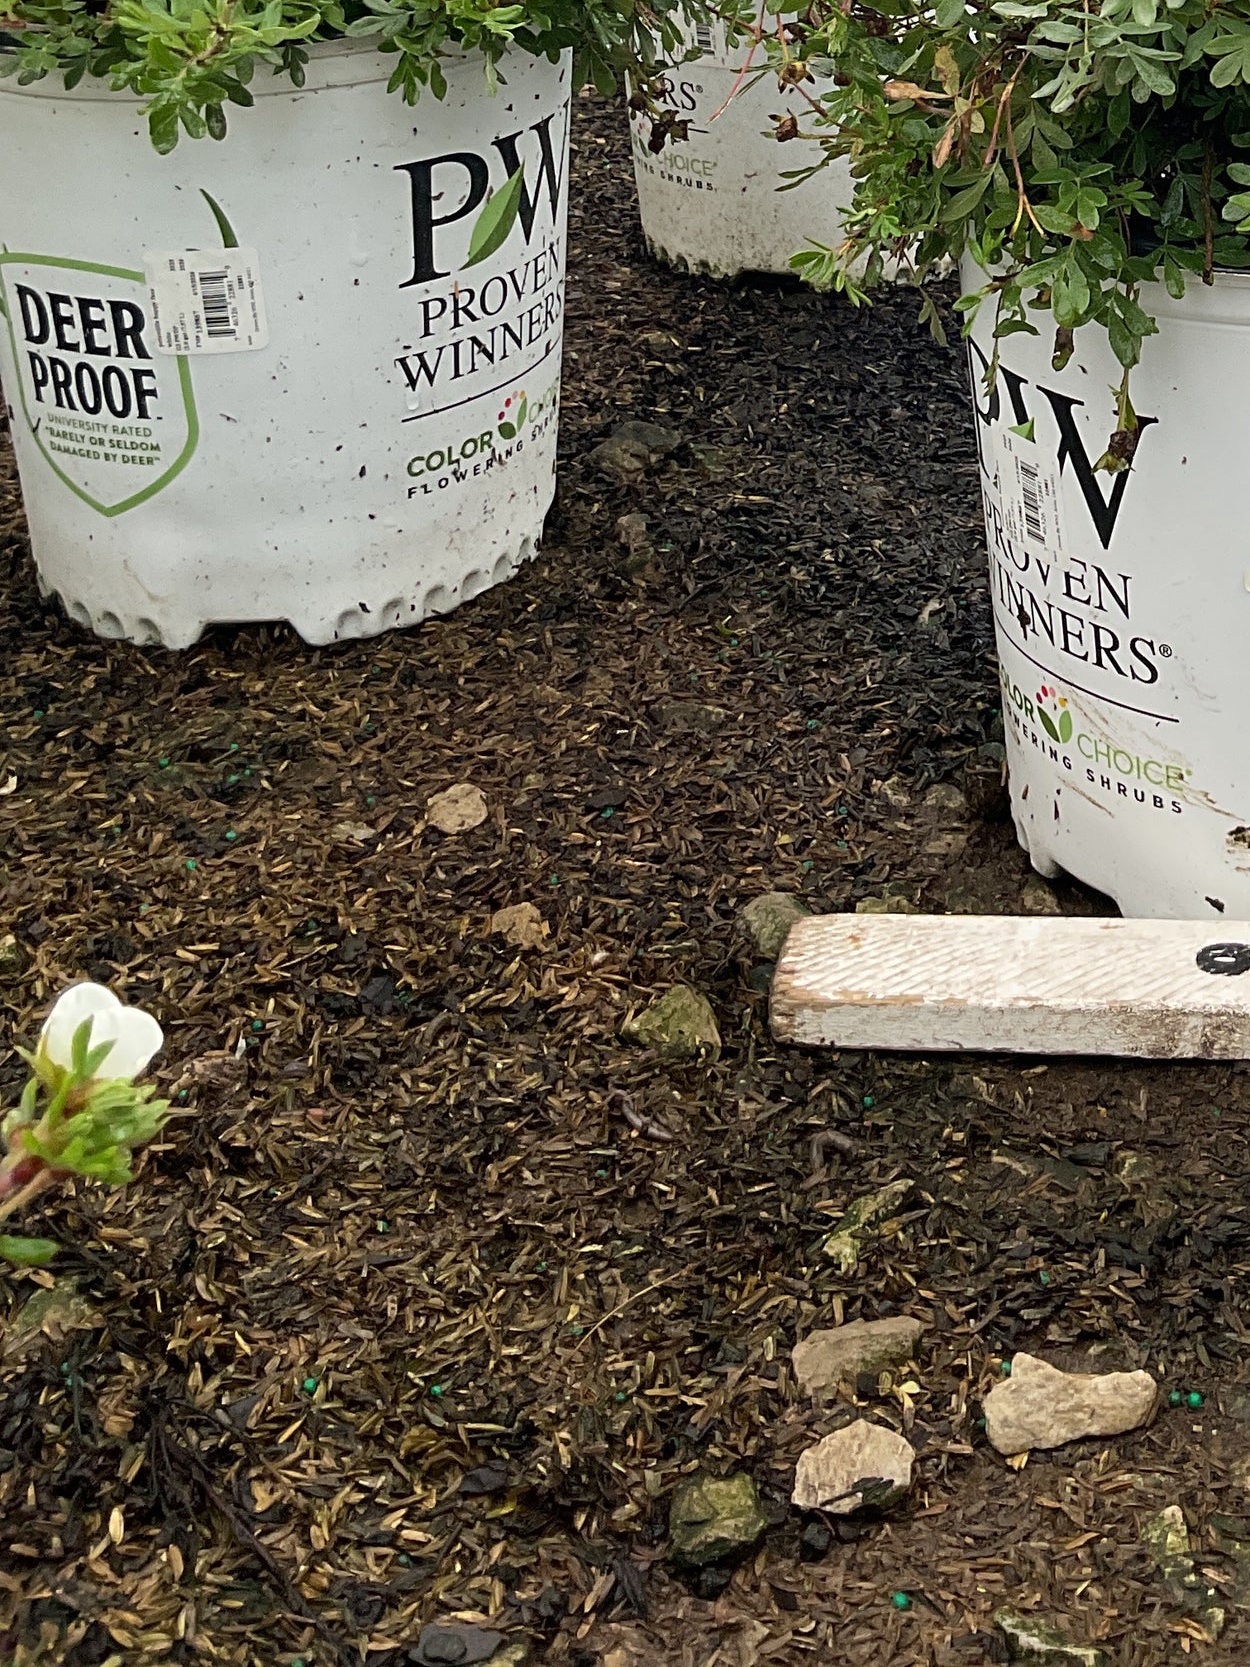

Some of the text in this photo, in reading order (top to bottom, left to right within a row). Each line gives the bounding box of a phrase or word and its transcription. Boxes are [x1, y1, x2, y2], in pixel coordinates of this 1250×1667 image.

[418, 236, 561, 340] PROVEN
[14, 283, 153, 360] DEER
[394, 279, 564, 392] WINNERS
[27, 350, 160, 420] PROOF
[47, 413, 153, 438] UNIVERSITY RATED
[50, 441, 101, 461] DAMAGED
[104, 452, 118, 463] BY
[89, 436, 106, 447] OR
[109, 438, 162, 453] SELDOM
[406, 430, 494, 478] COLOR
[1076, 733, 1186, 792] CHOICE
[1085, 767, 1183, 815] SHRUBS
